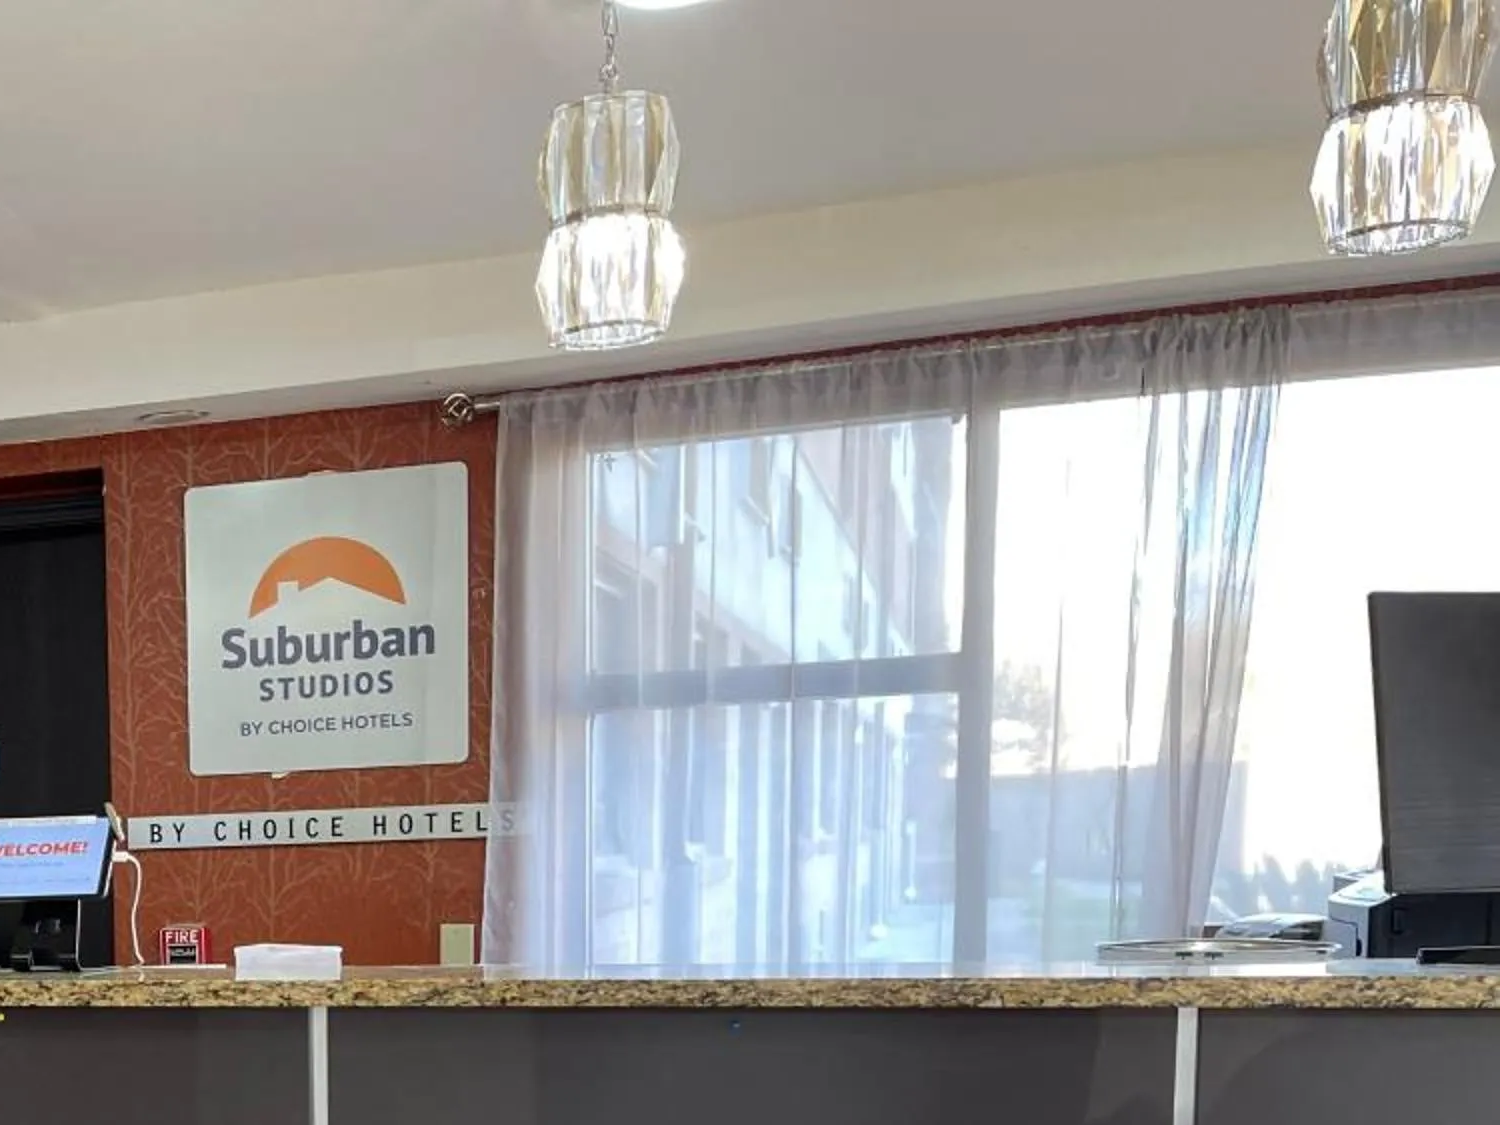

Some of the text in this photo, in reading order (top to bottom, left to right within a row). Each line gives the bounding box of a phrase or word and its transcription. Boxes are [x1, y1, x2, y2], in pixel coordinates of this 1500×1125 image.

[221, 619, 436, 670] Suburban
[259, 670, 394, 702] STUDIOS
[240, 712, 413, 737] BY CHOICE HOTELS
[150, 809, 514, 845] BY CHOICE HOTELS
[165, 930, 199, 944] FIRE
